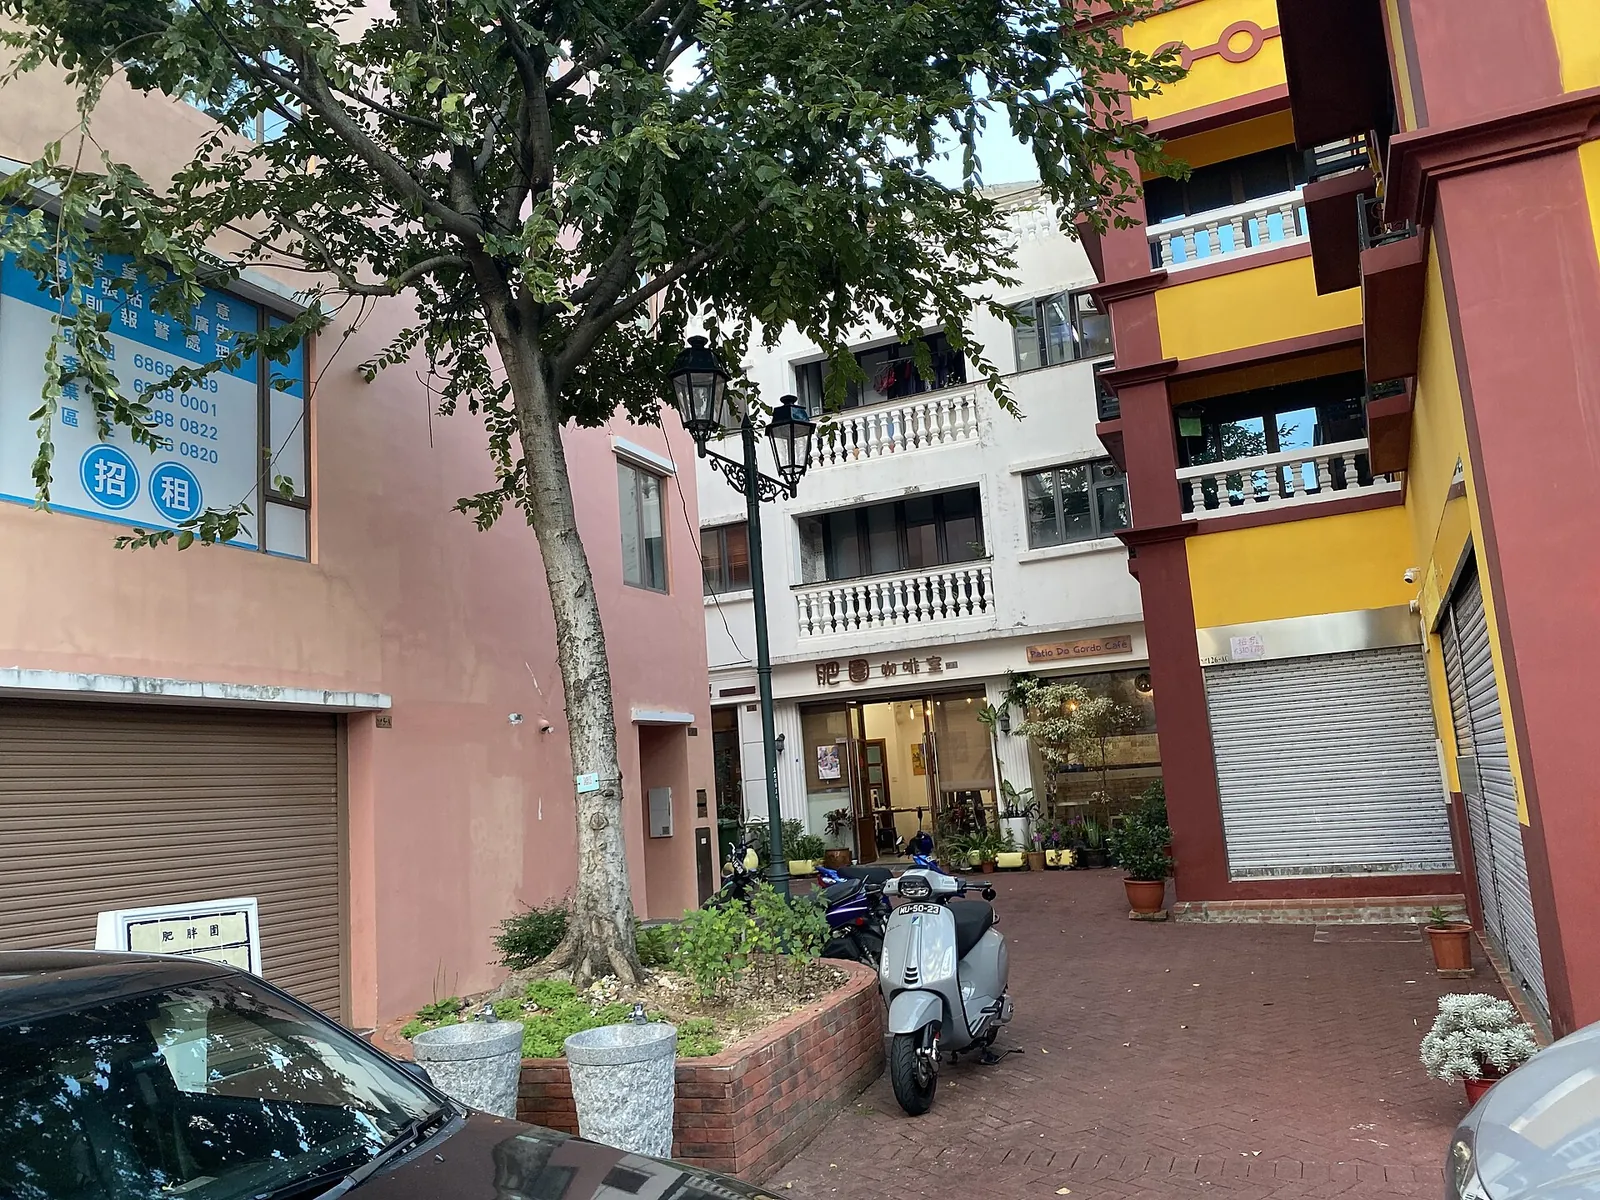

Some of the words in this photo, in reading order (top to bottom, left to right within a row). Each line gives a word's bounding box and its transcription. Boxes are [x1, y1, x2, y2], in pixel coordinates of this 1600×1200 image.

[180, 394, 217, 417] 0001
[180, 418, 218, 441] 0822
[180, 442, 218, 464] 0820
[1030, 649, 1053, 659] Patio
[1073, 644, 1102, 654] Gordo
